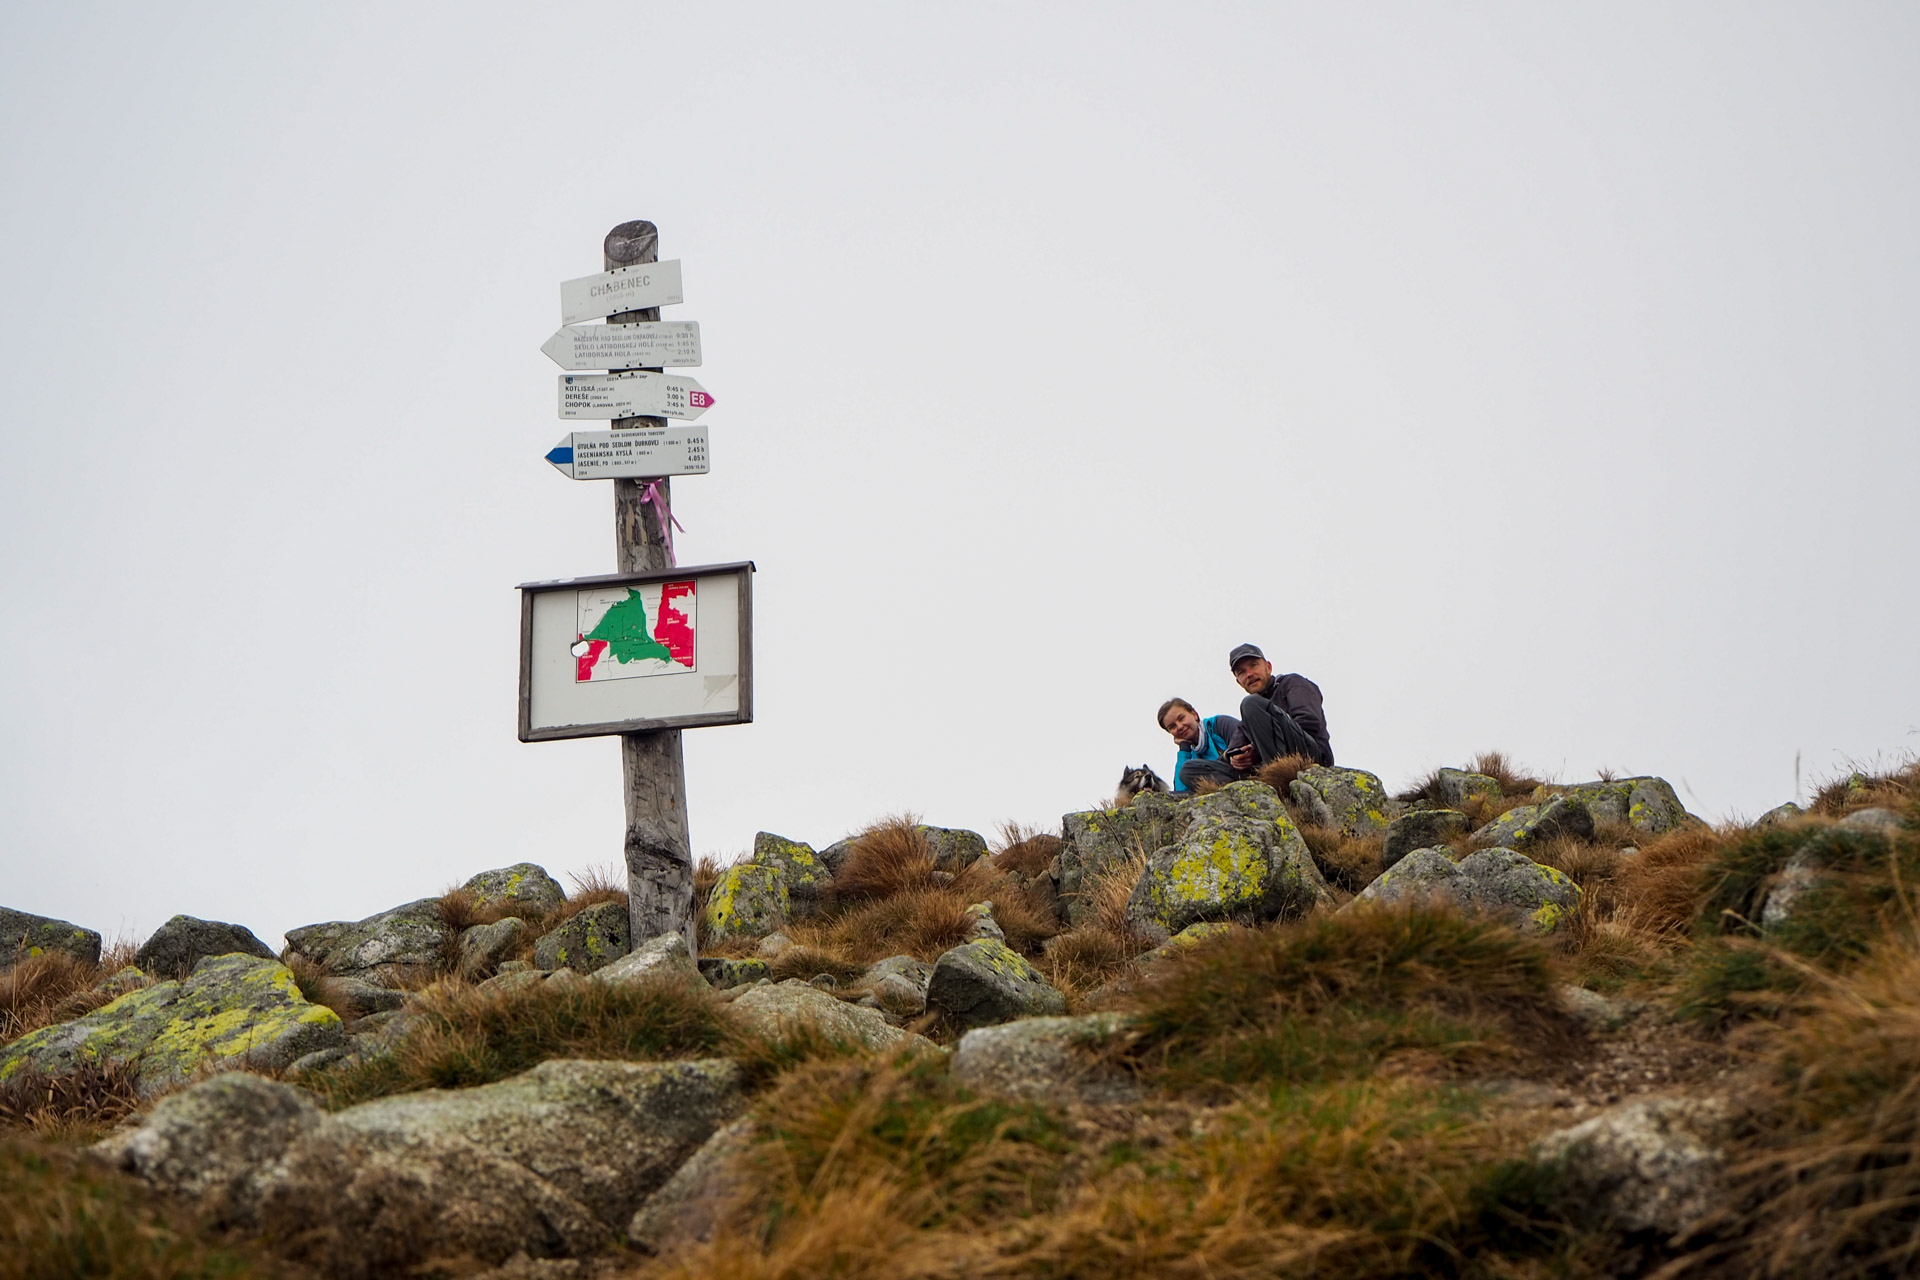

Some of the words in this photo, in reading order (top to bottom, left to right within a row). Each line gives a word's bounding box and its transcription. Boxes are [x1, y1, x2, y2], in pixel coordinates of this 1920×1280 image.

[590, 275, 650, 297] CHABENEC
[597, 342, 637, 350] LATIBORSKEJ
[691, 393, 705, 406] E8
[577, 451, 613, 459] JASENIANSKA
